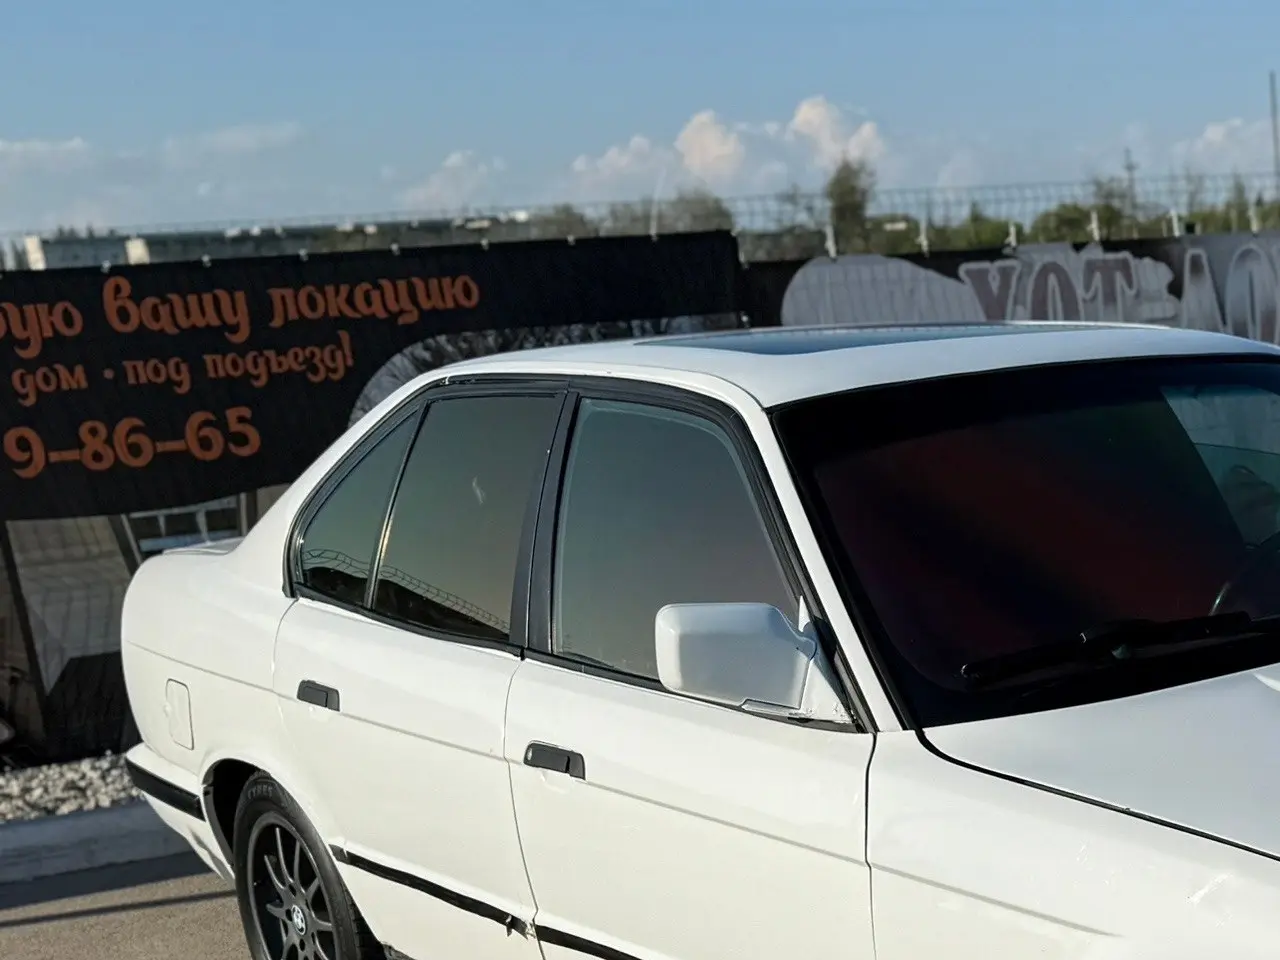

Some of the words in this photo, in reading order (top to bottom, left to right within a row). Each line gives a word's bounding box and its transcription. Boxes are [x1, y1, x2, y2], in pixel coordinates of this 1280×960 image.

[102, 275, 251, 344] вашу
[267, 275, 480, 328] локацию
[11, 363, 88, 407] дом
[123, 356, 192, 395] под
[203, 330, 354, 388] подъезд!
